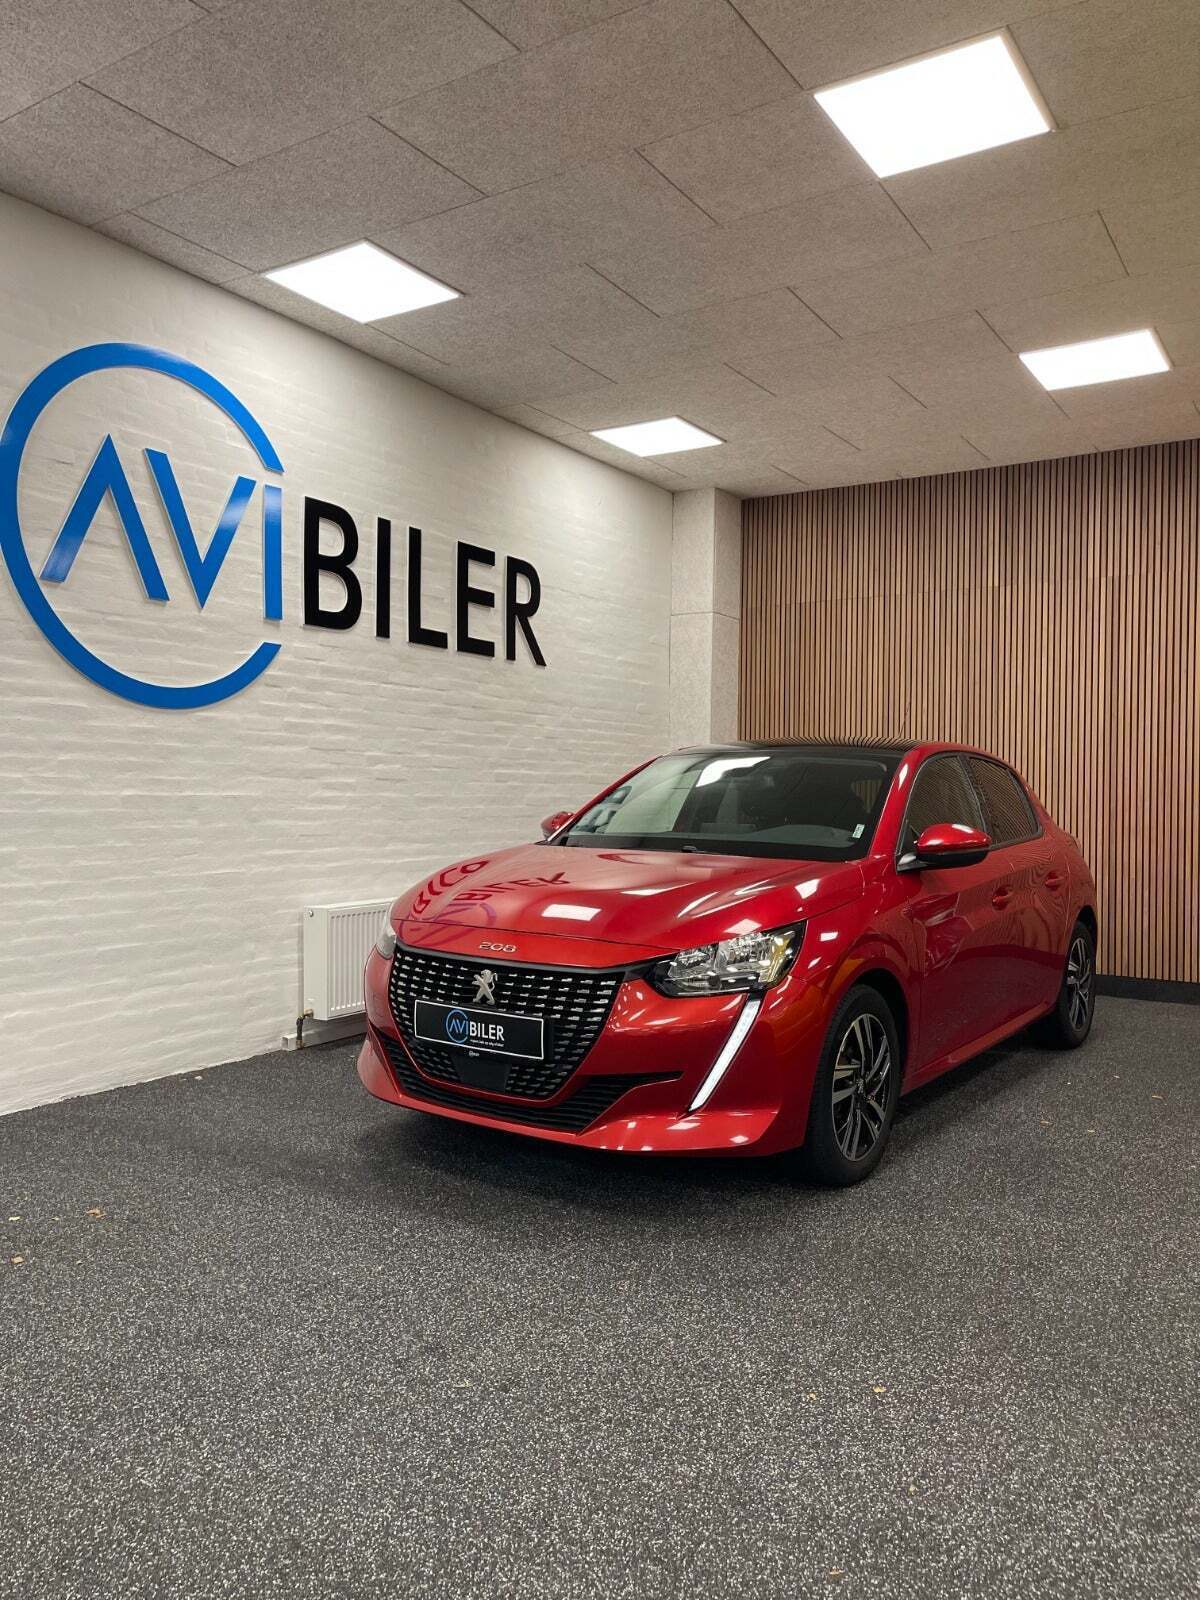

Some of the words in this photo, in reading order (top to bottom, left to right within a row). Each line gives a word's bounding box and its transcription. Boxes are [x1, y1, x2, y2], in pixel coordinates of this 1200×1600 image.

[303, 495, 547, 668] BILER
[479, 941, 517, 953] 208
[469, 1021, 505, 1042] BILER
